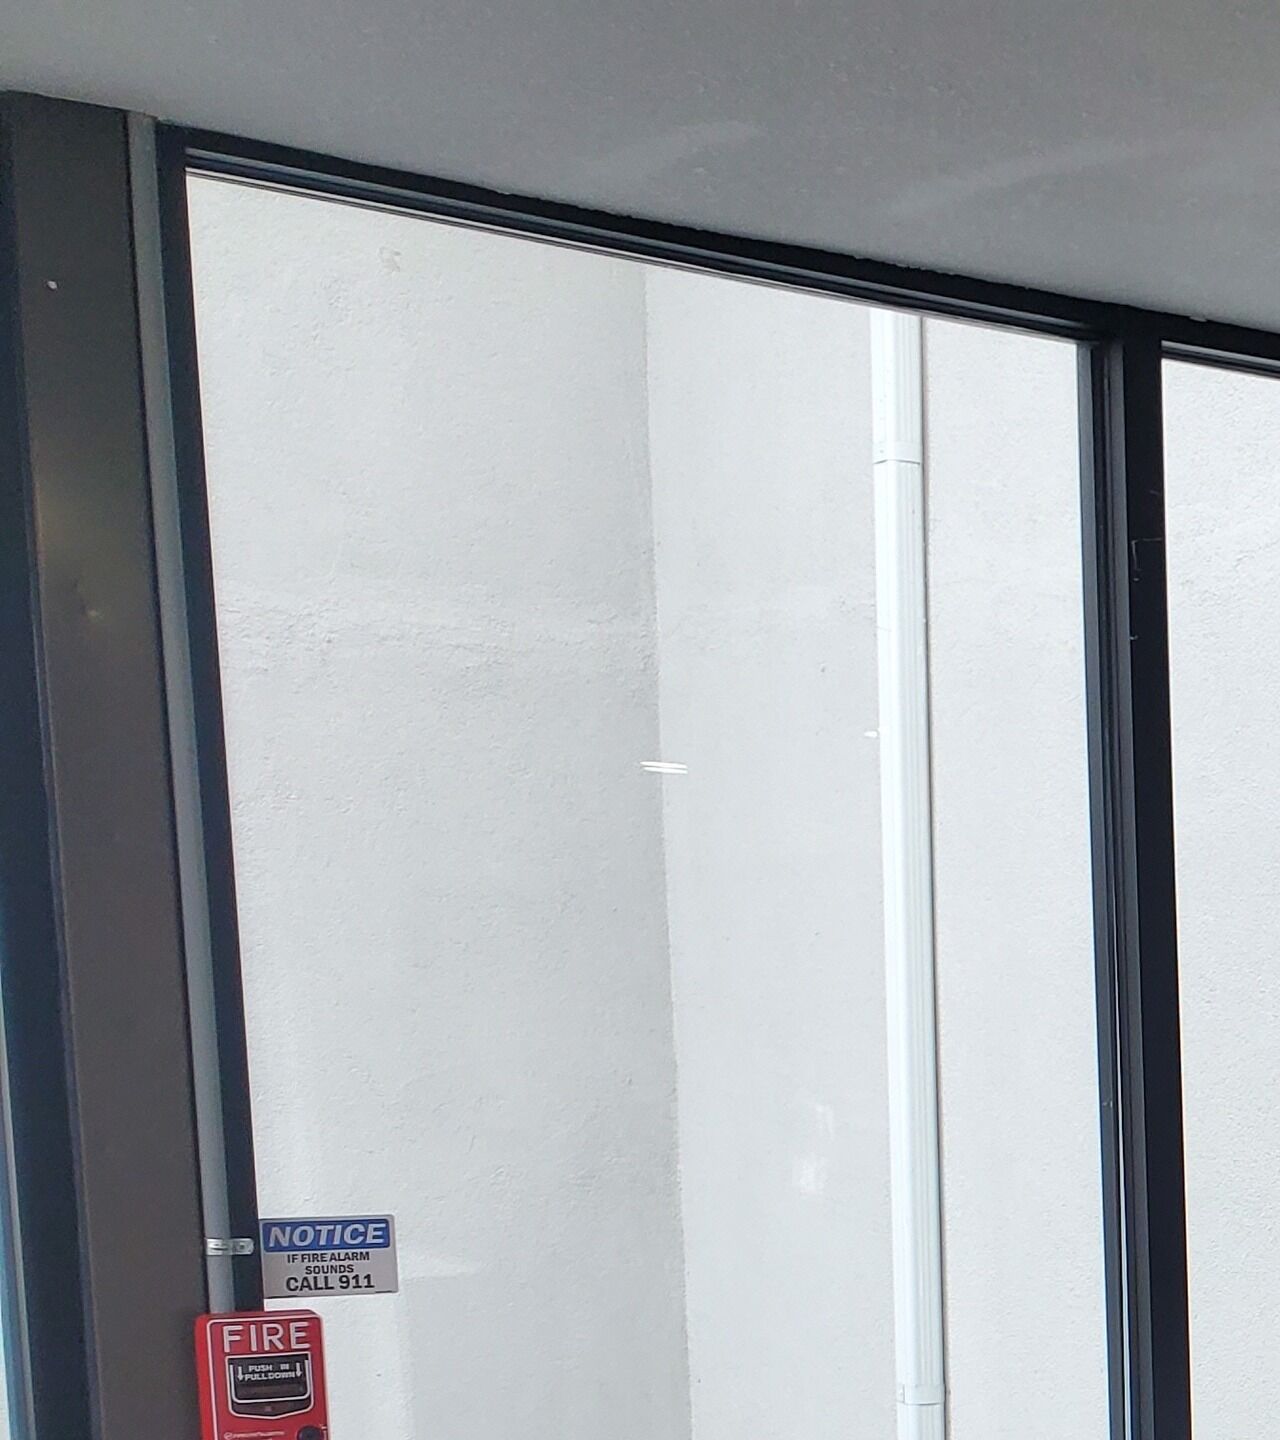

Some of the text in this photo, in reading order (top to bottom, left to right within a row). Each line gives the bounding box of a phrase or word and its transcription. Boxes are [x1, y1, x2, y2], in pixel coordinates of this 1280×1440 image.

[268, 1222, 387, 1248] NOTICE
[287, 1251, 370, 1264] IF FIRE ALARM
[305, 1264, 354, 1275] SOUNDS
[286, 1273, 375, 1292] CALL 911
[223, 1321, 311, 1353] FIRE
[248, 1364, 272, 1372] PUSH
[244, 1371, 296, 1381] PULL DOWN
